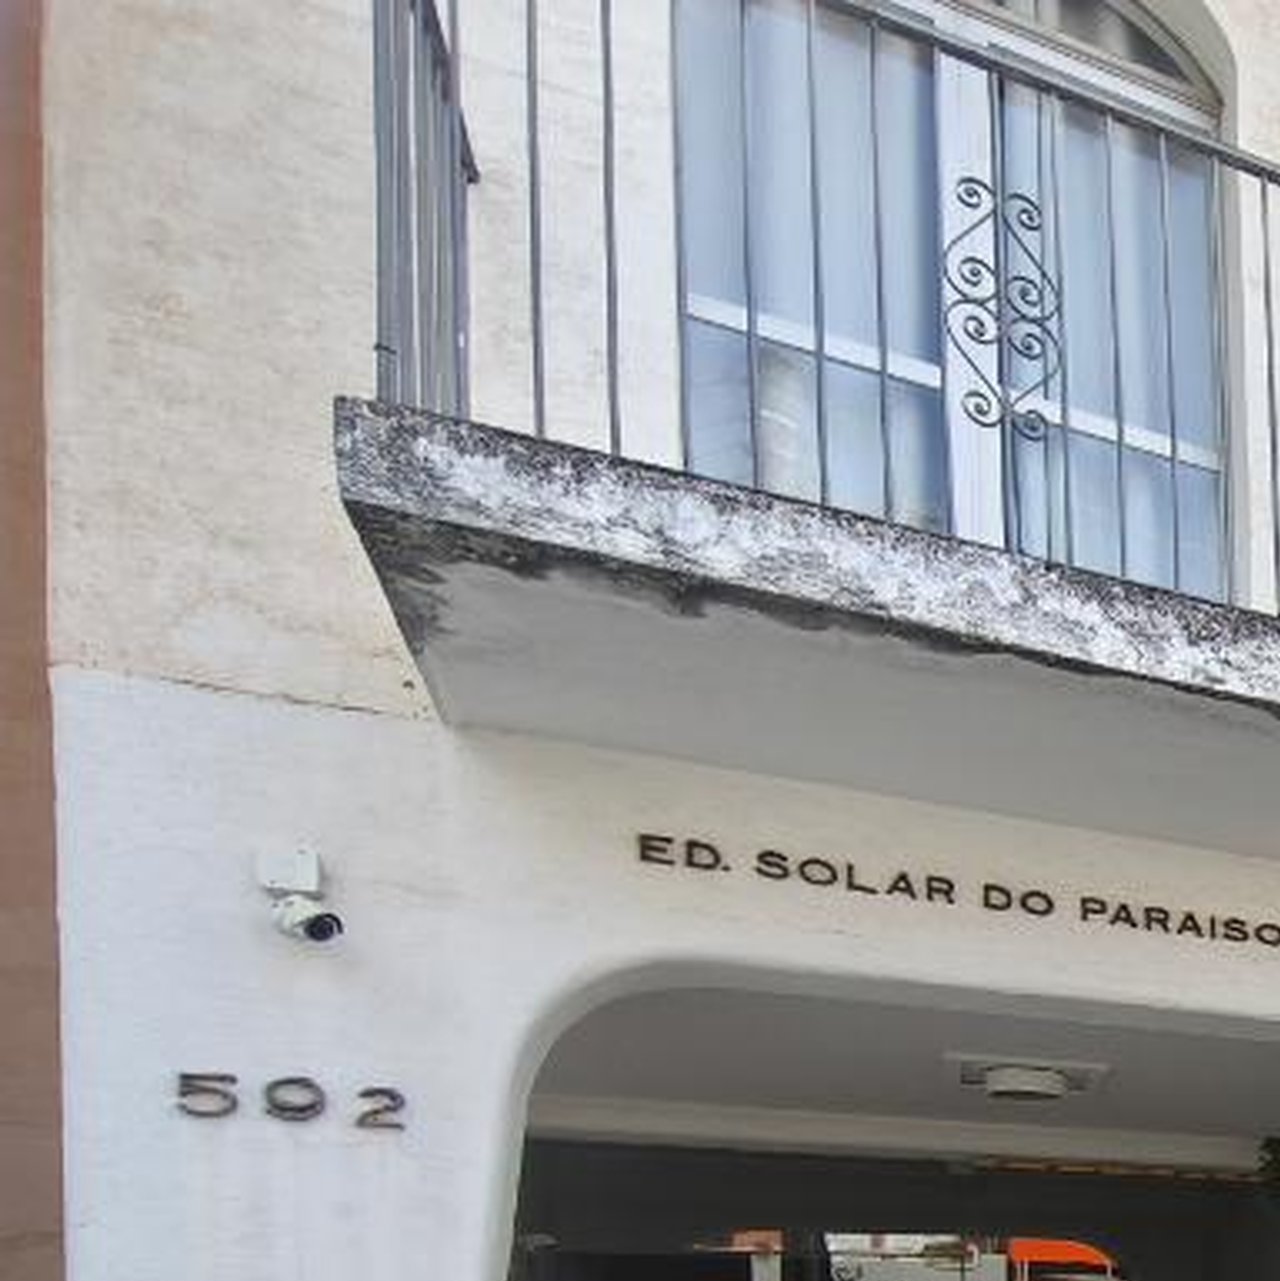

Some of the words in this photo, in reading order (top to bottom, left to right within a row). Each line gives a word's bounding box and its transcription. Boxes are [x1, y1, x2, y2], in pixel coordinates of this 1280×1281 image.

[637, 832, 732, 873] ED.
[754, 850, 956, 905] SOLAR
[982, 882, 1055, 917] DO
[176, 1072, 407, 1132] 592
